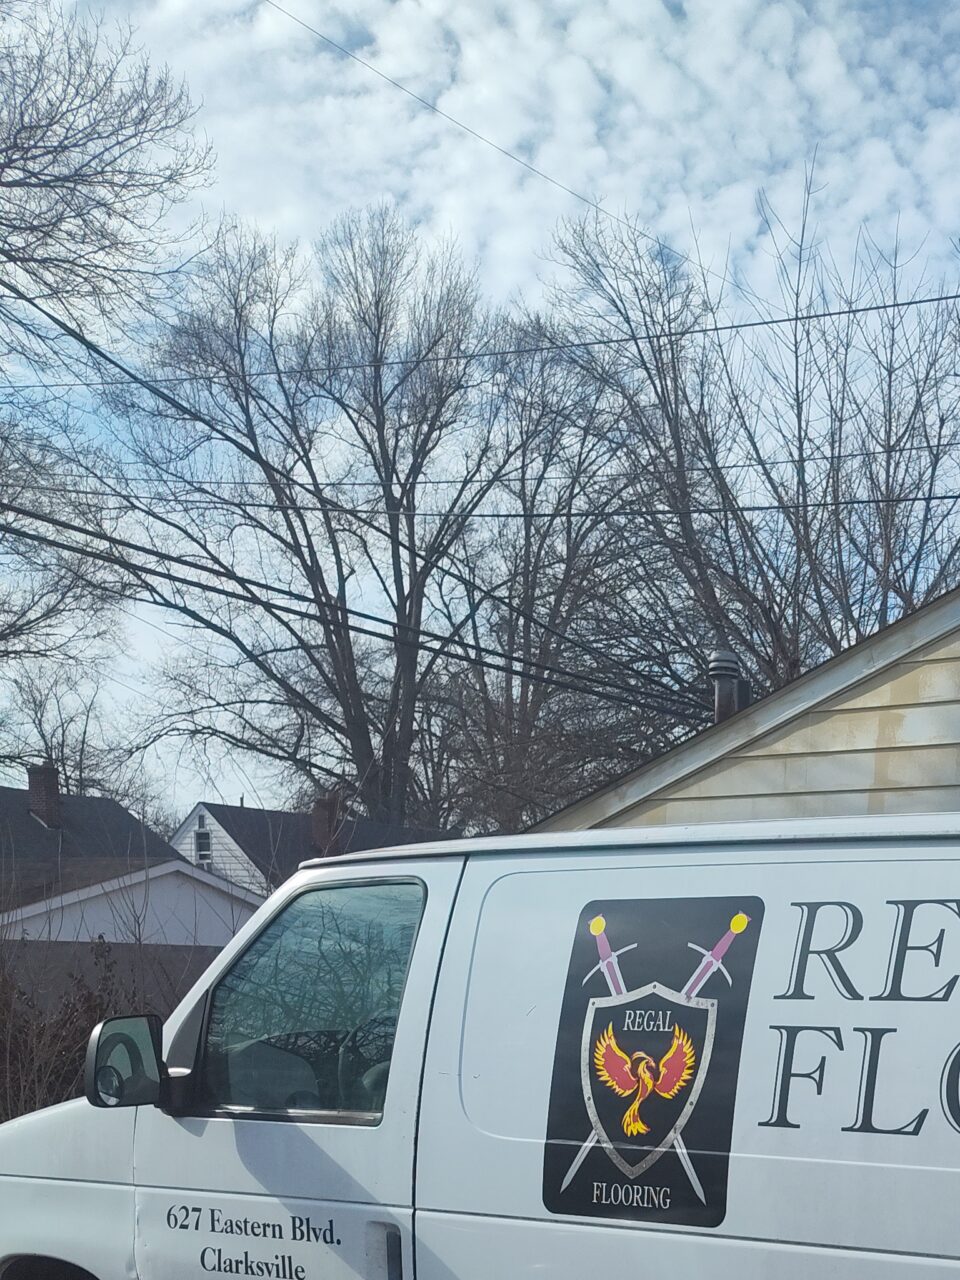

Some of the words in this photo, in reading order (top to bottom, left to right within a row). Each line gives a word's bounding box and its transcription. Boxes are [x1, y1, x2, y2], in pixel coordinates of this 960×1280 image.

[623, 1010, 674, 1032] REGAL
[592, 1182, 671, 1209] FLOORING
[166, 1204, 202, 1230] 627
[209, 1208, 284, 1240] Eastern
[290, 1215, 342, 1245] Blvd.
[200, 1246, 306, 1280] Clarksville
